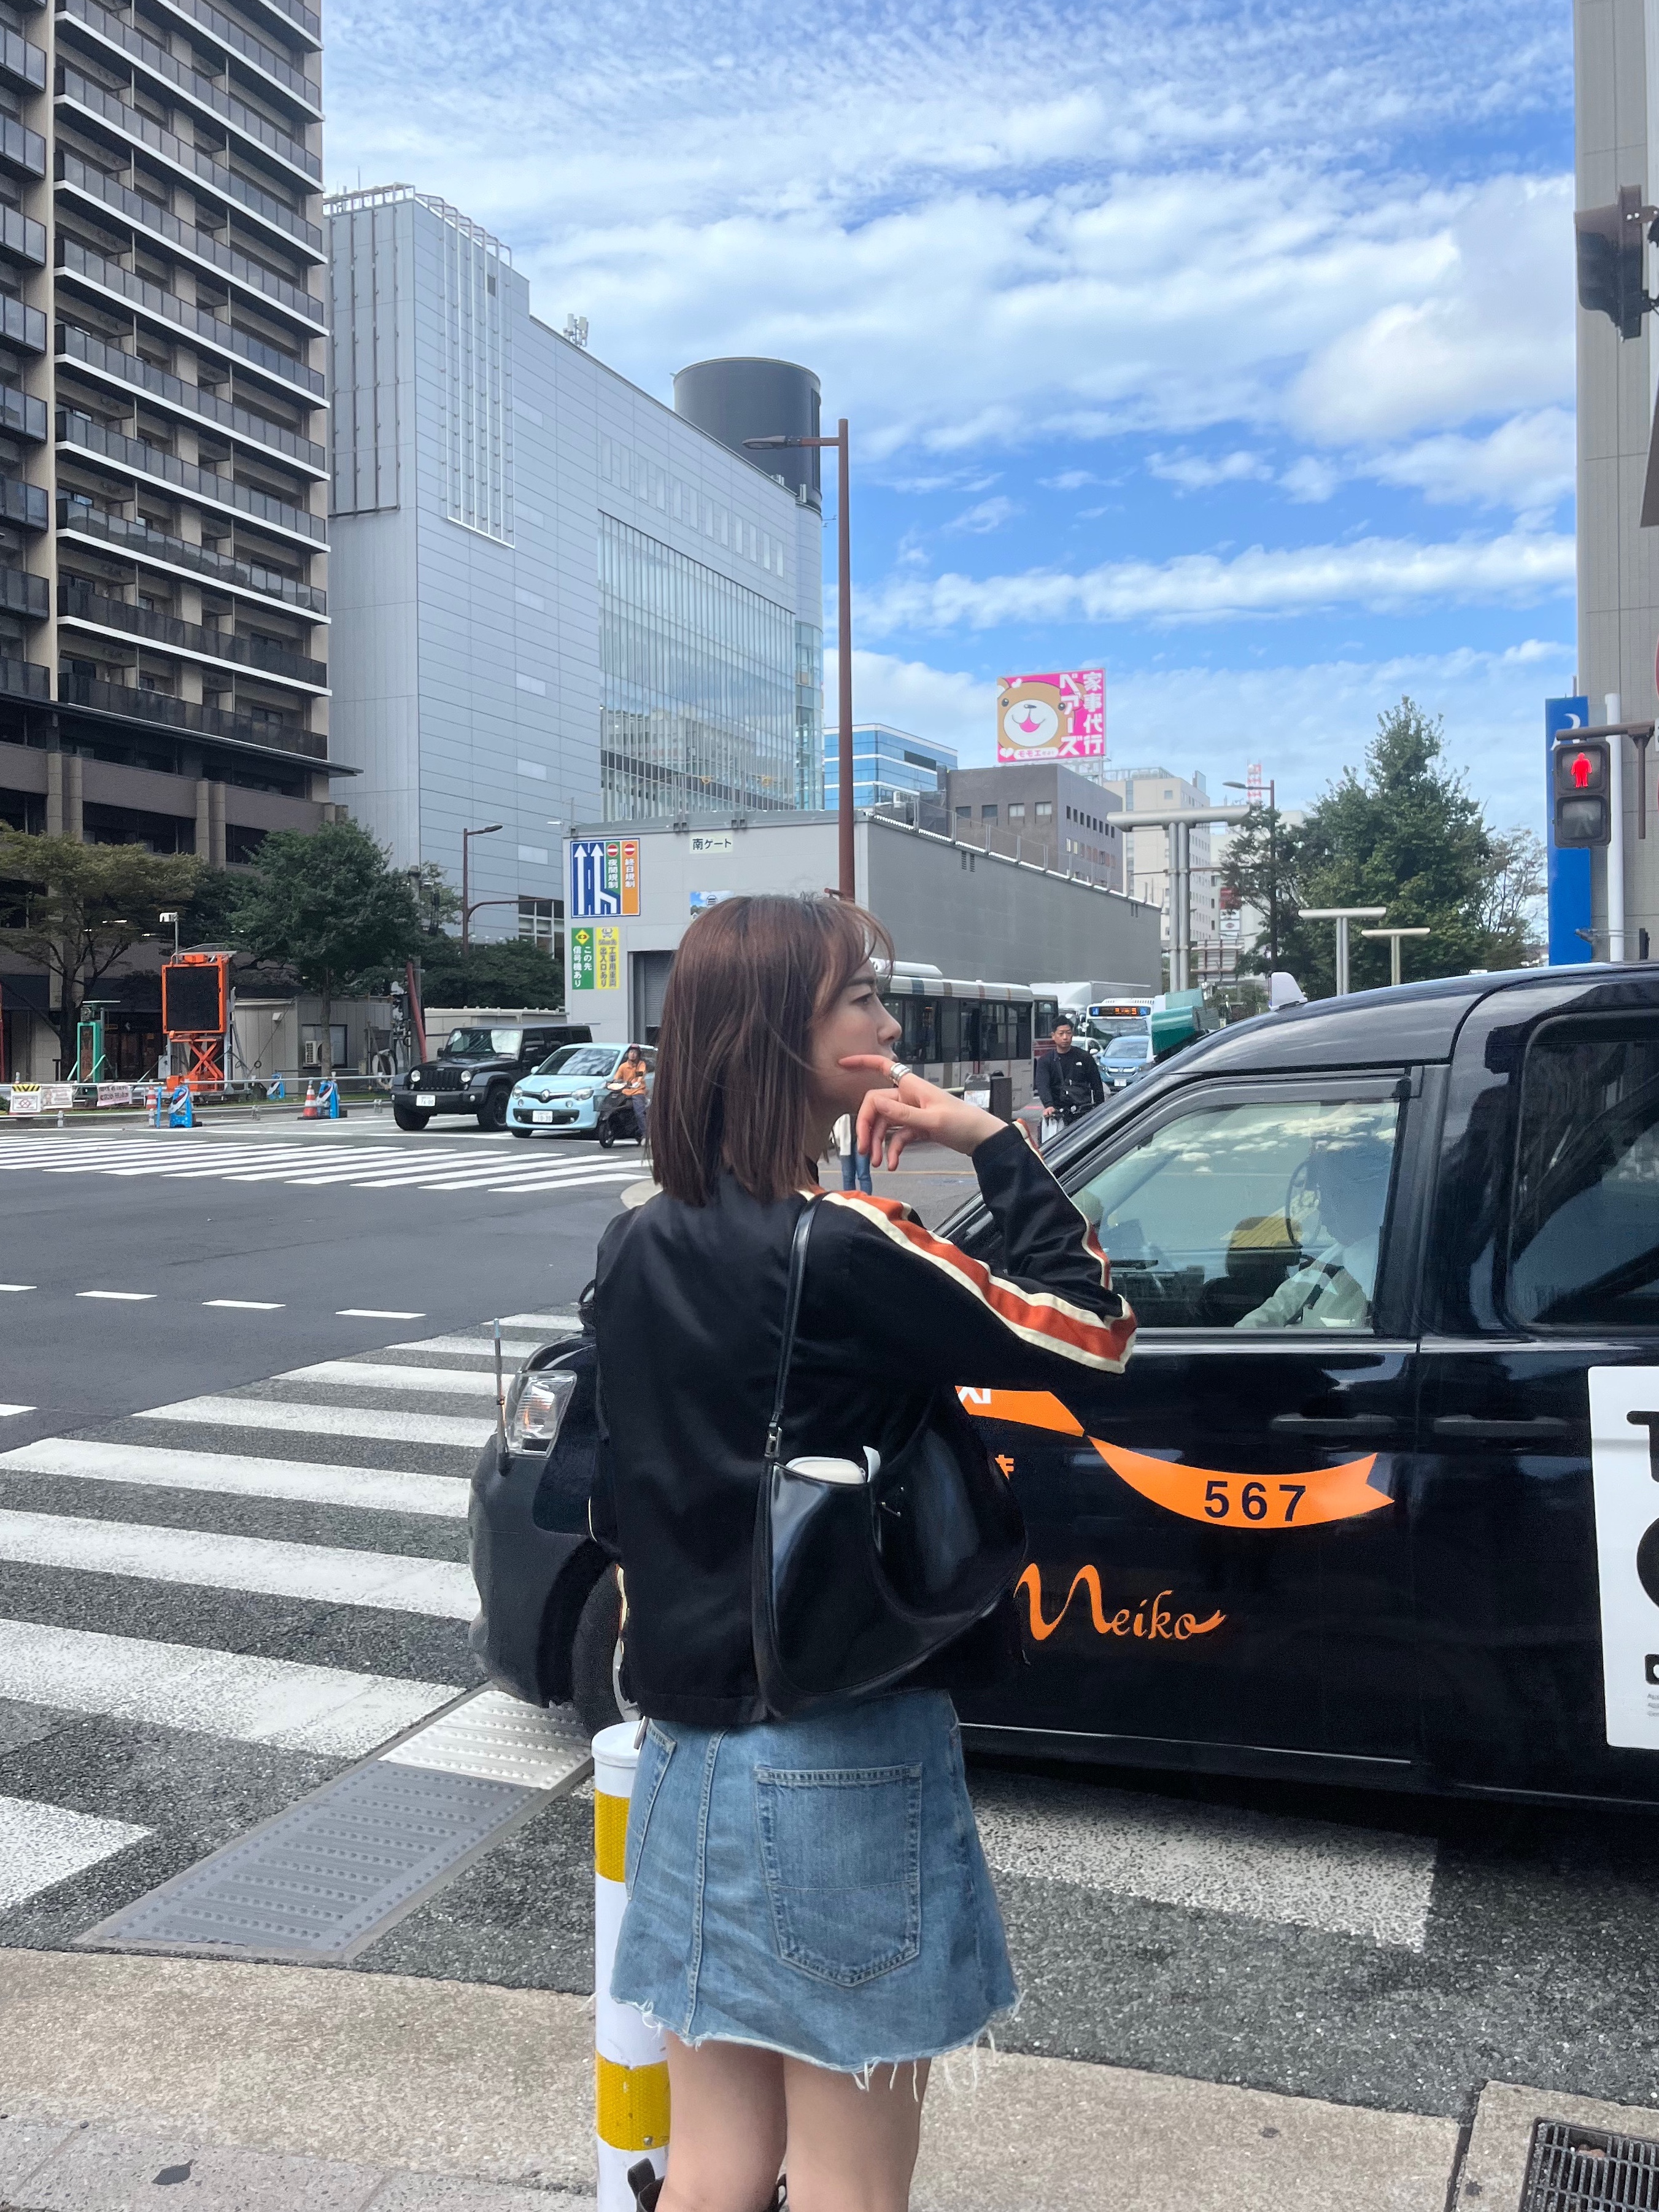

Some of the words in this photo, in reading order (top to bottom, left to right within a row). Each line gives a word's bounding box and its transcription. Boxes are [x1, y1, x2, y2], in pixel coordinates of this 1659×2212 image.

[1058, 673, 1083, 756] ベアーズ
[1083, 671, 1102, 754] 家事代行
[692, 838, 732, 851] 南ゲート
[573, 945, 582, 988] 信号機あり
[583, 946, 592, 971] この先
[1204, 1480, 1306, 1522] 567
[1013, 1563, 1226, 1641] Meiko
